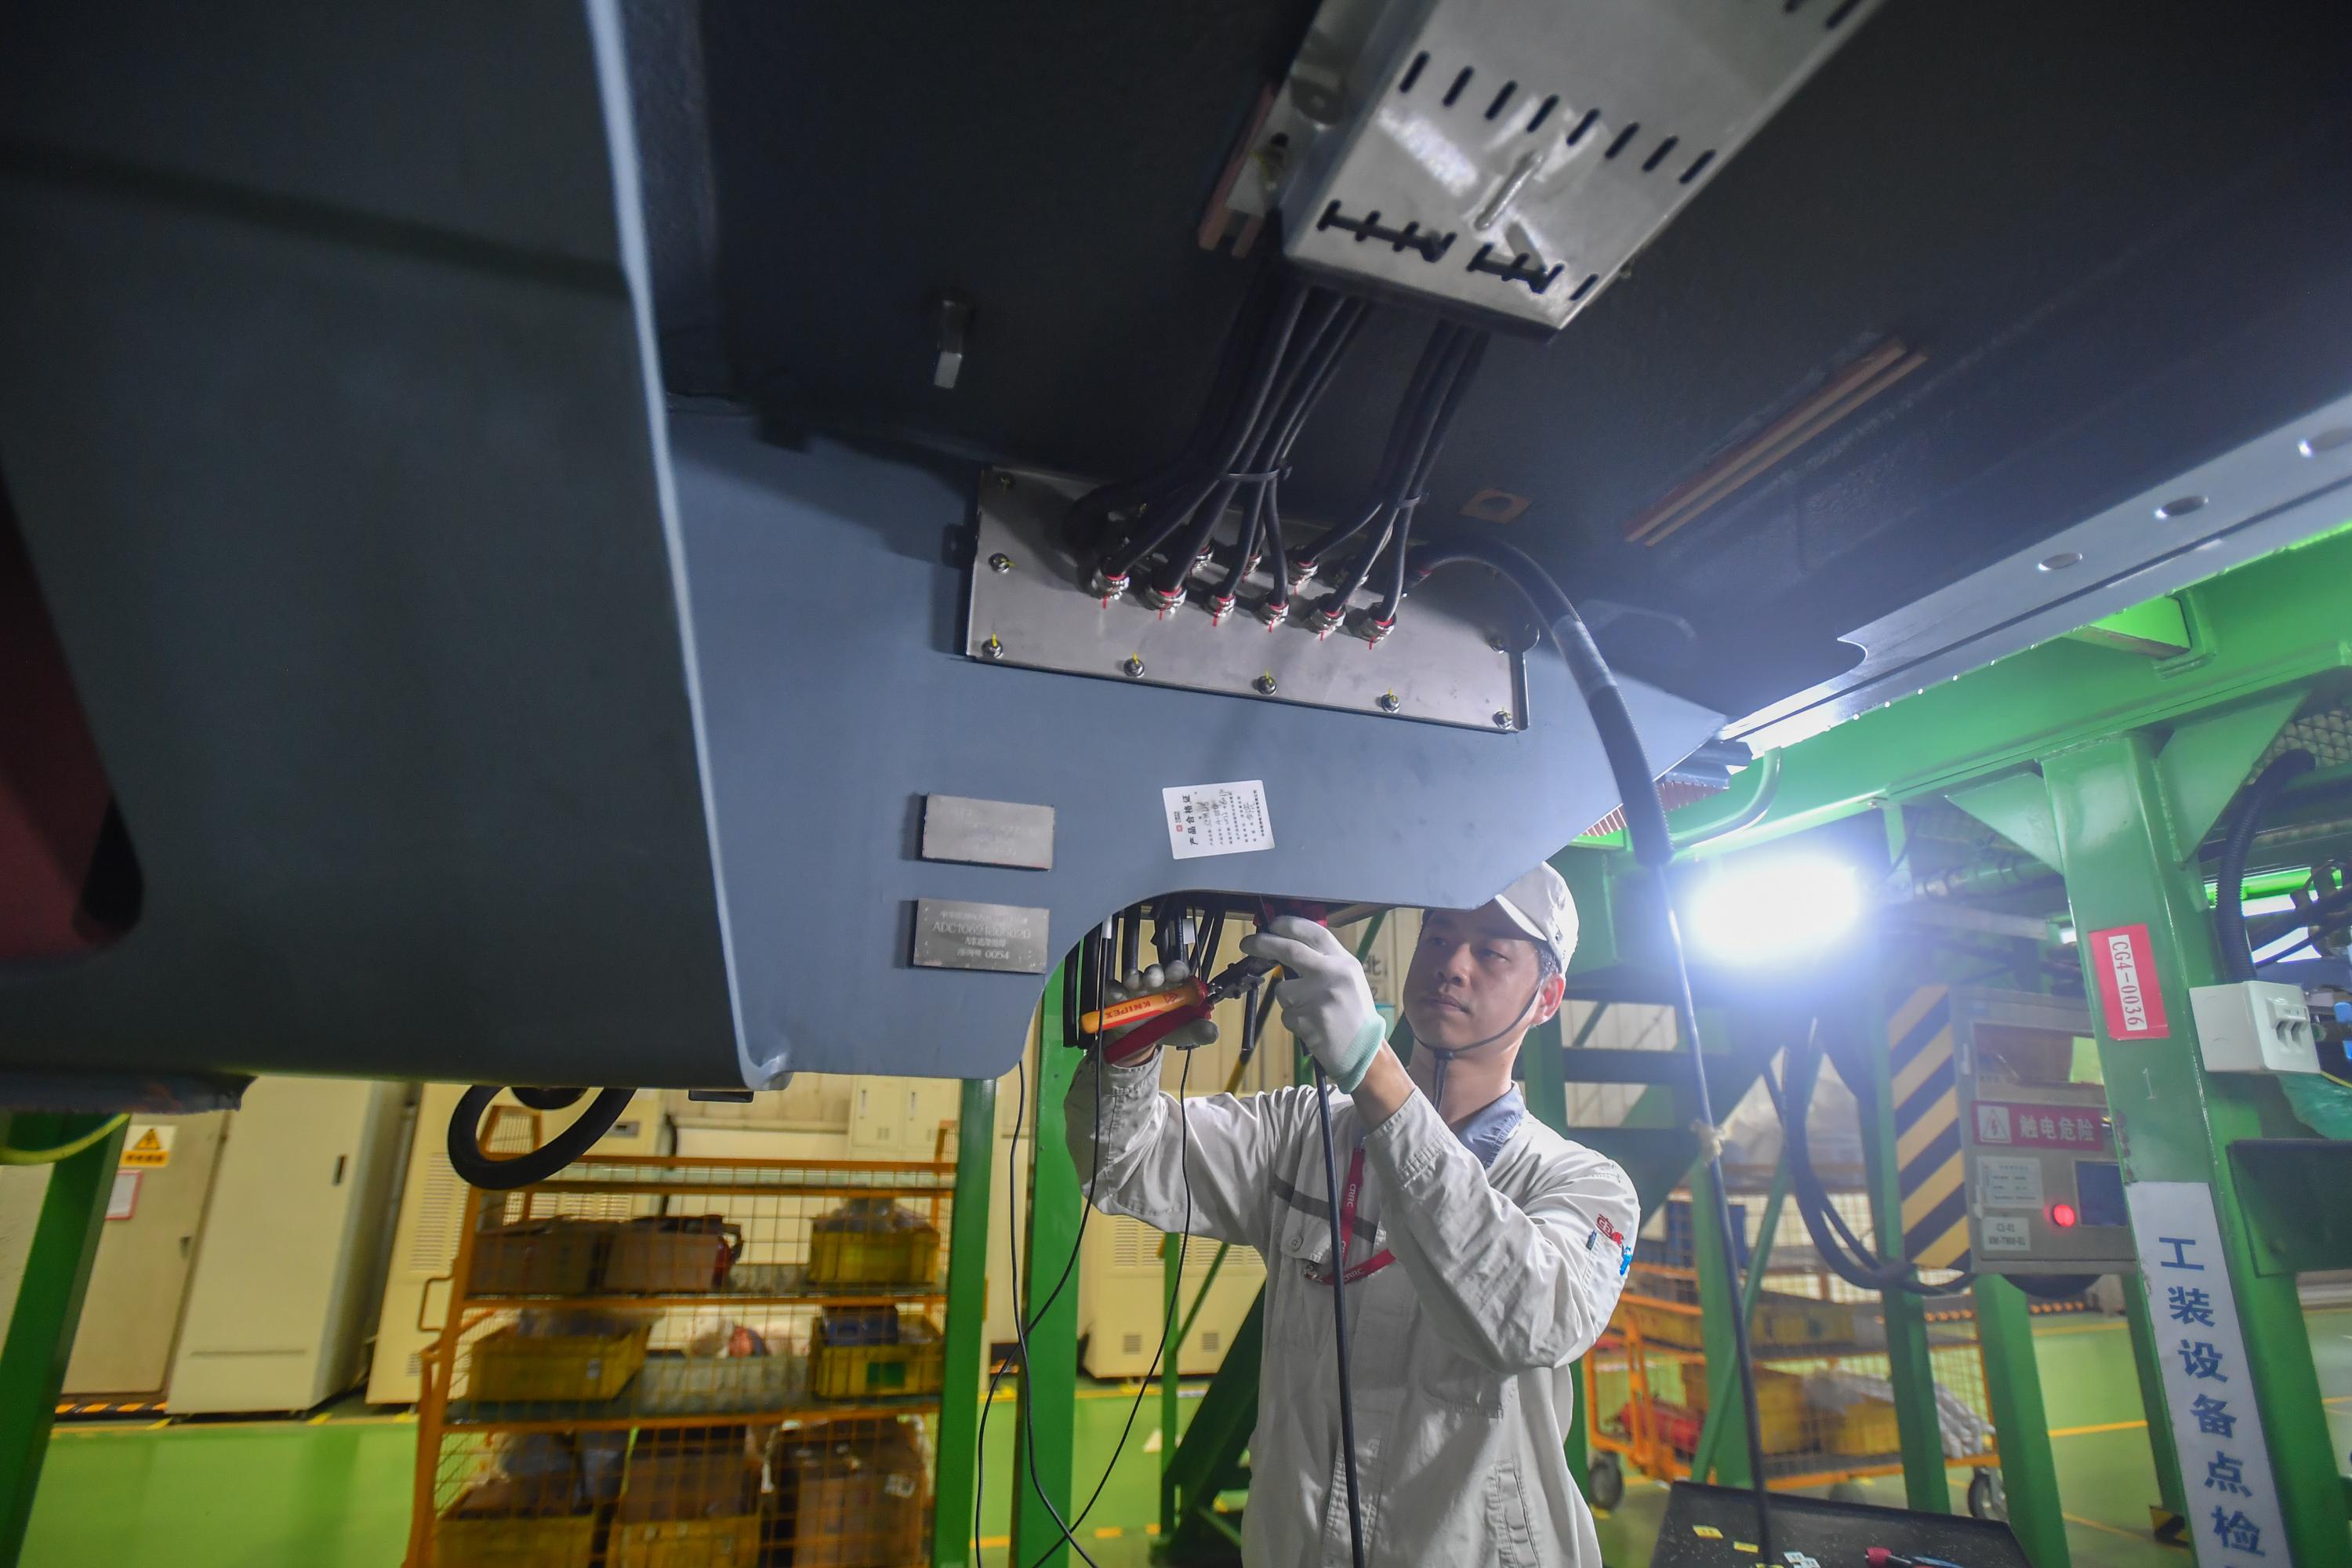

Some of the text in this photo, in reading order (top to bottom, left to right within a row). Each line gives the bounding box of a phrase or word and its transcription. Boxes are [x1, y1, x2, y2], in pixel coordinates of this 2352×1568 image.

[1182, 794, 1199, 845] 产品合格证
[985, 950, 1010, 960] 0054
[2112, 942, 2144, 1025] CG4-0036
[1105, 1000, 1151, 1019] KNIPEX
[2019, 1114, 2095, 1142] 触电危险
[1347, 1184, 1356, 1208] CRRC
[2158, 1236, 2267, 1568] 工装设备点检
